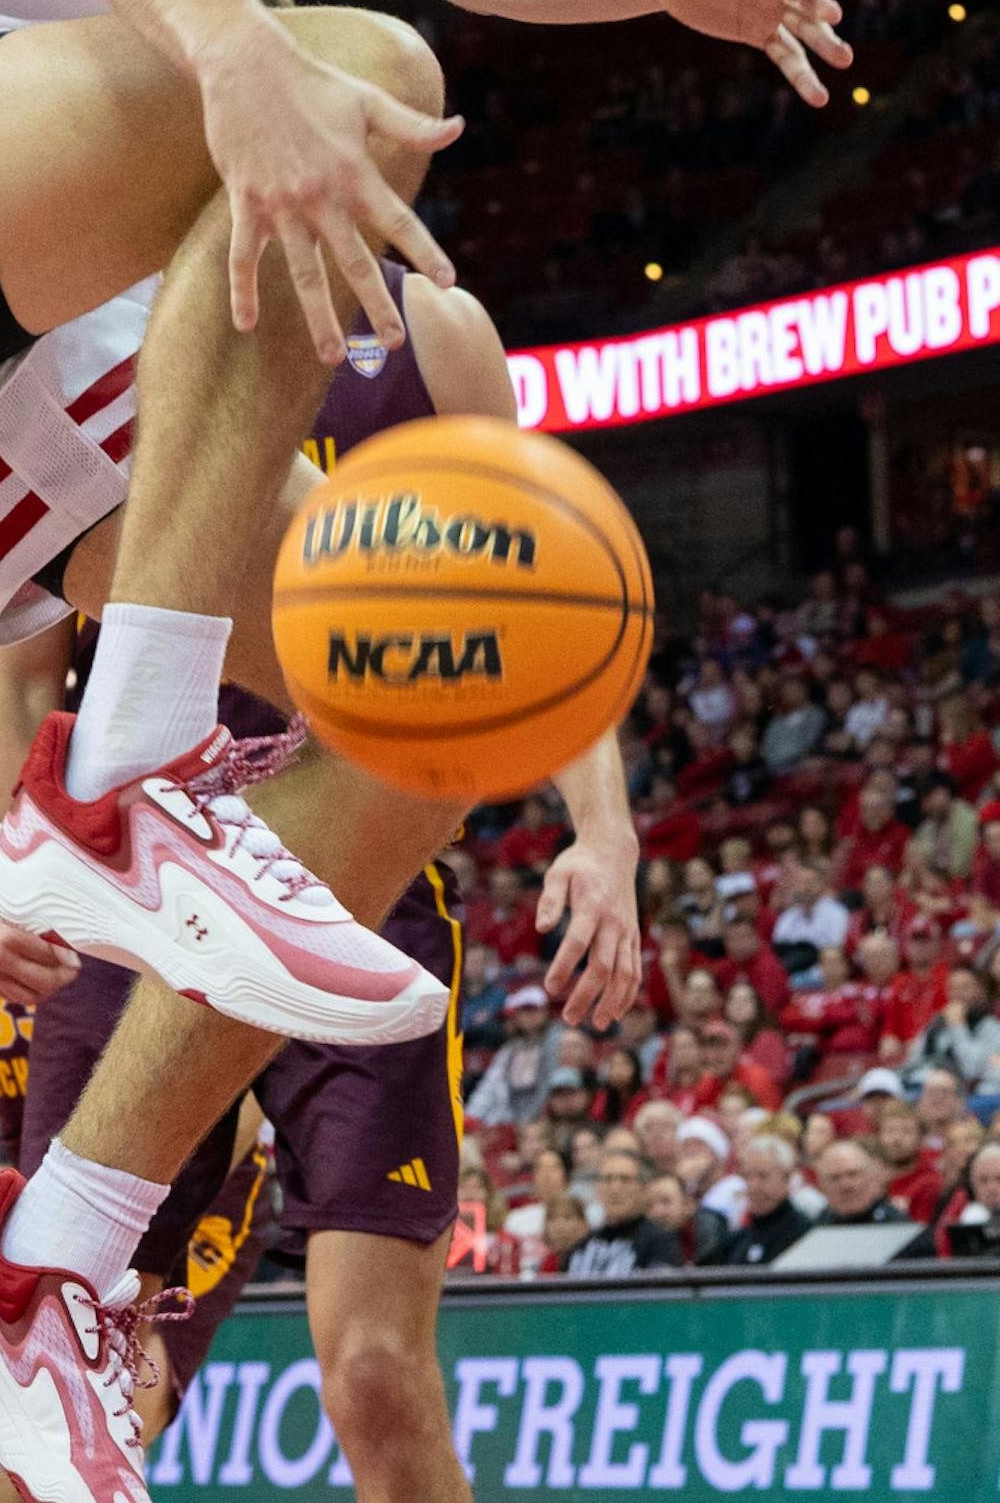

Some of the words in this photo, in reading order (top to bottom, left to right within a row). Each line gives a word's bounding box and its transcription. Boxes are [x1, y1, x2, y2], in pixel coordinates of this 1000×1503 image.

[554, 327, 702, 424] WITH
[705, 292, 848, 398] BREW
[852, 265, 963, 364] PUB
[302, 491, 536, 570] Wilson
[327, 628, 503, 686] NCAA
[452, 1347, 966, 1491] FREIGHT
